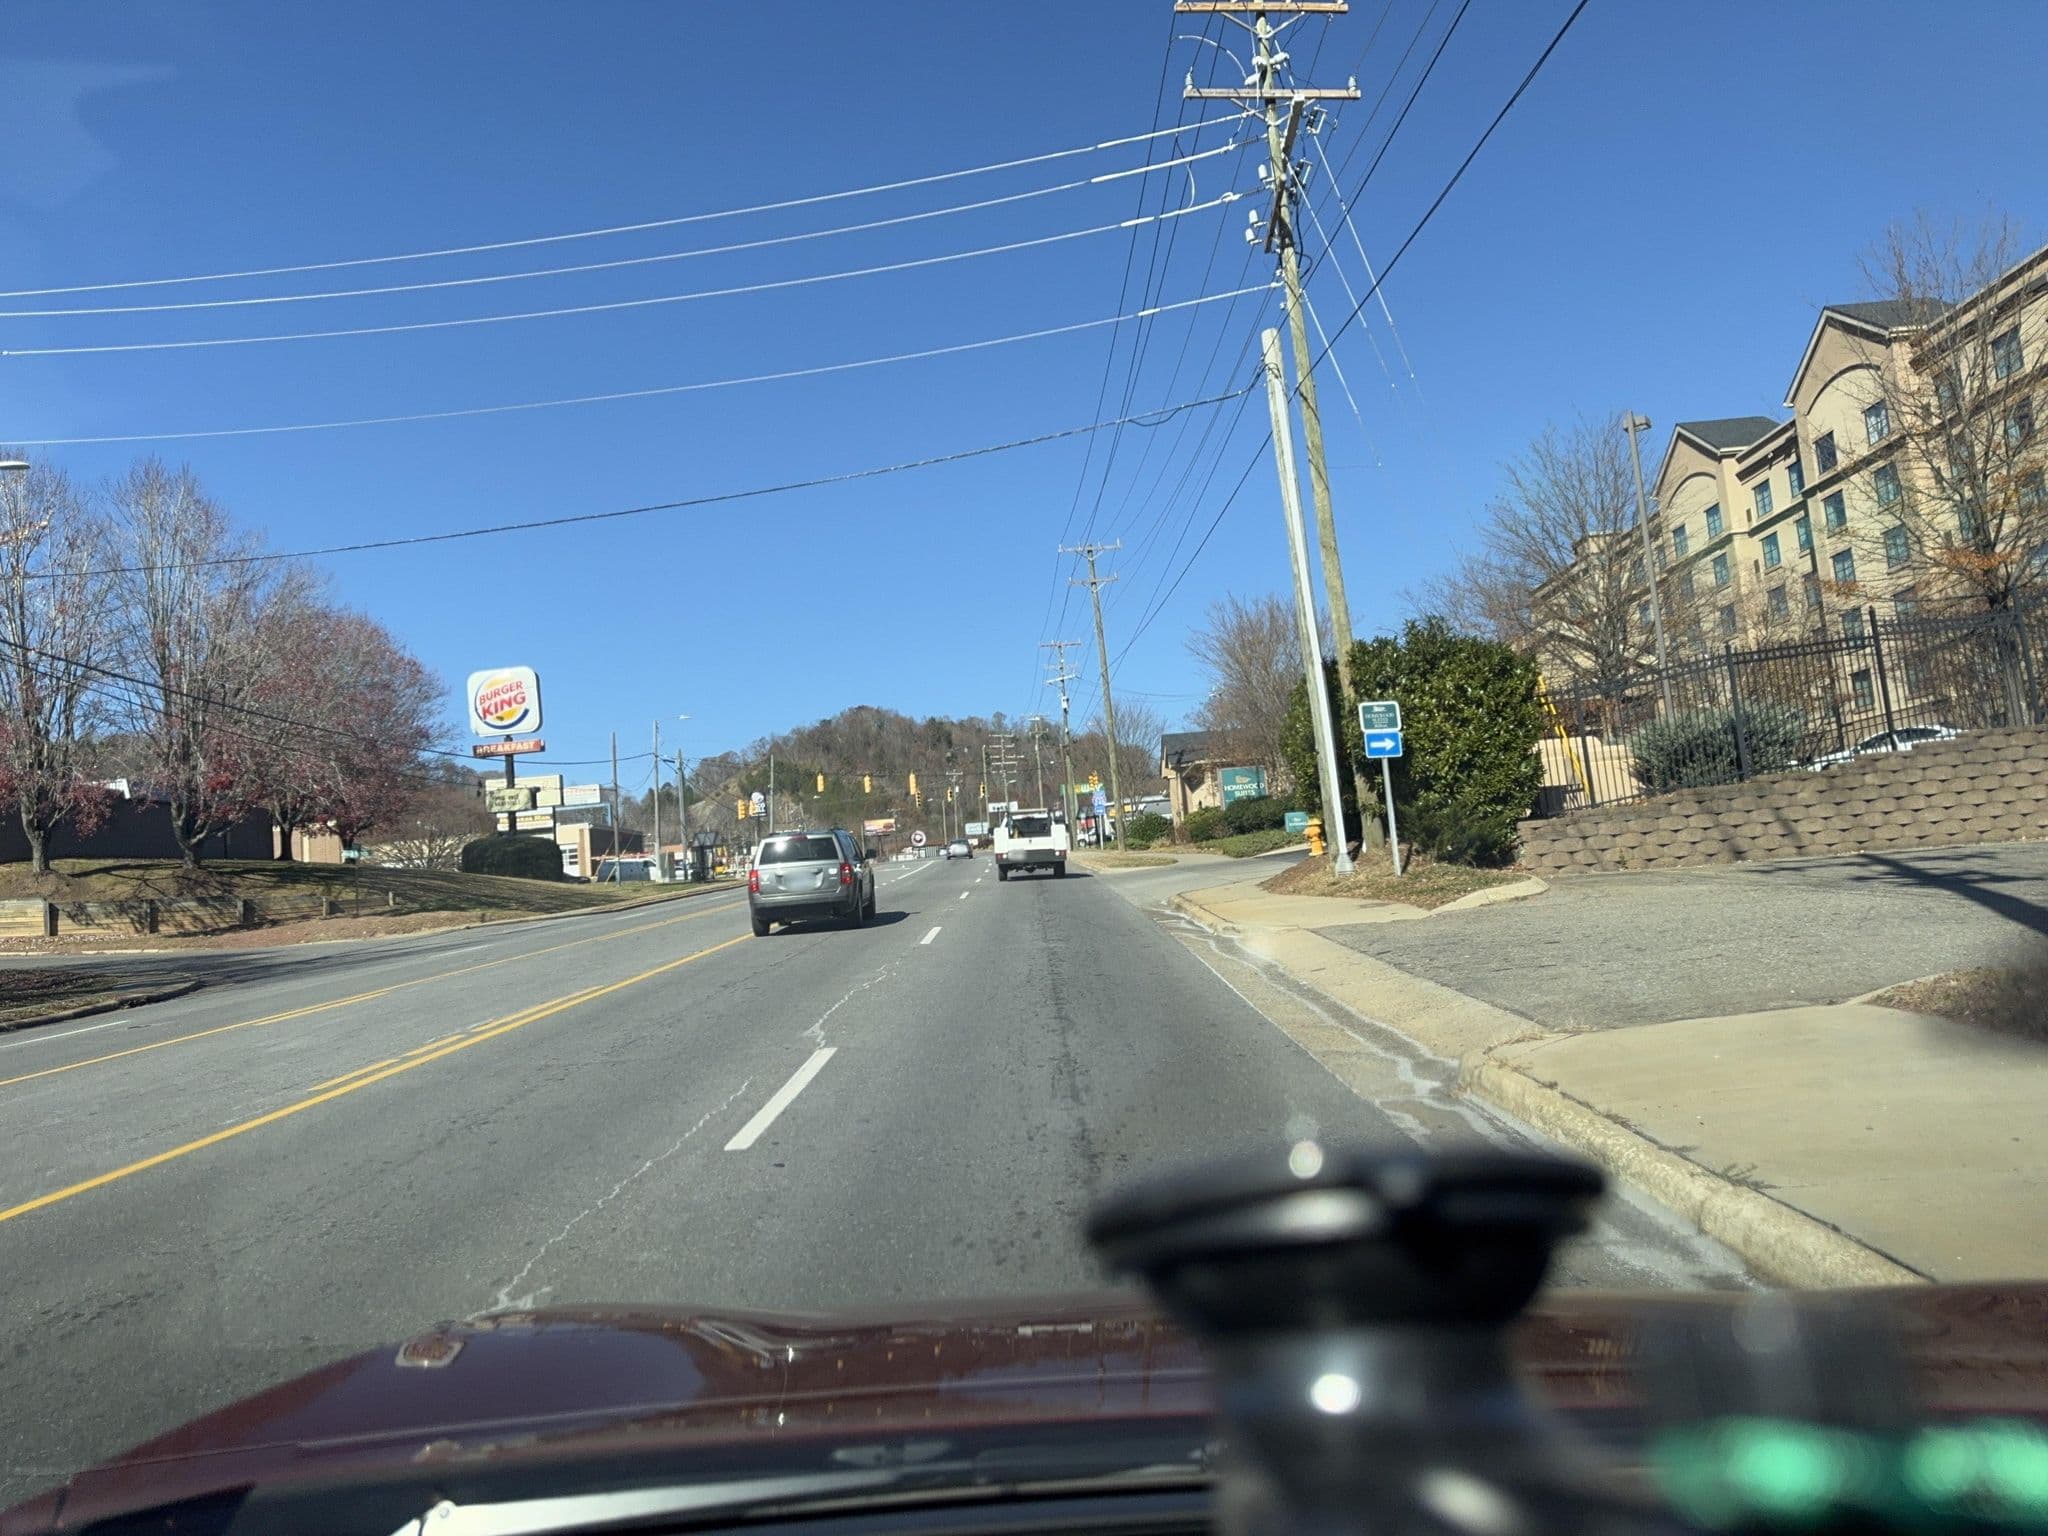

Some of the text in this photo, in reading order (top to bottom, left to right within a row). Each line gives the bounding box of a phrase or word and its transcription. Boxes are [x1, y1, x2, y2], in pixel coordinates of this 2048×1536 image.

[479, 681, 523, 705] BURGER
[481, 692, 526, 720] KING
[475, 741, 534, 755] BREAKFAST
